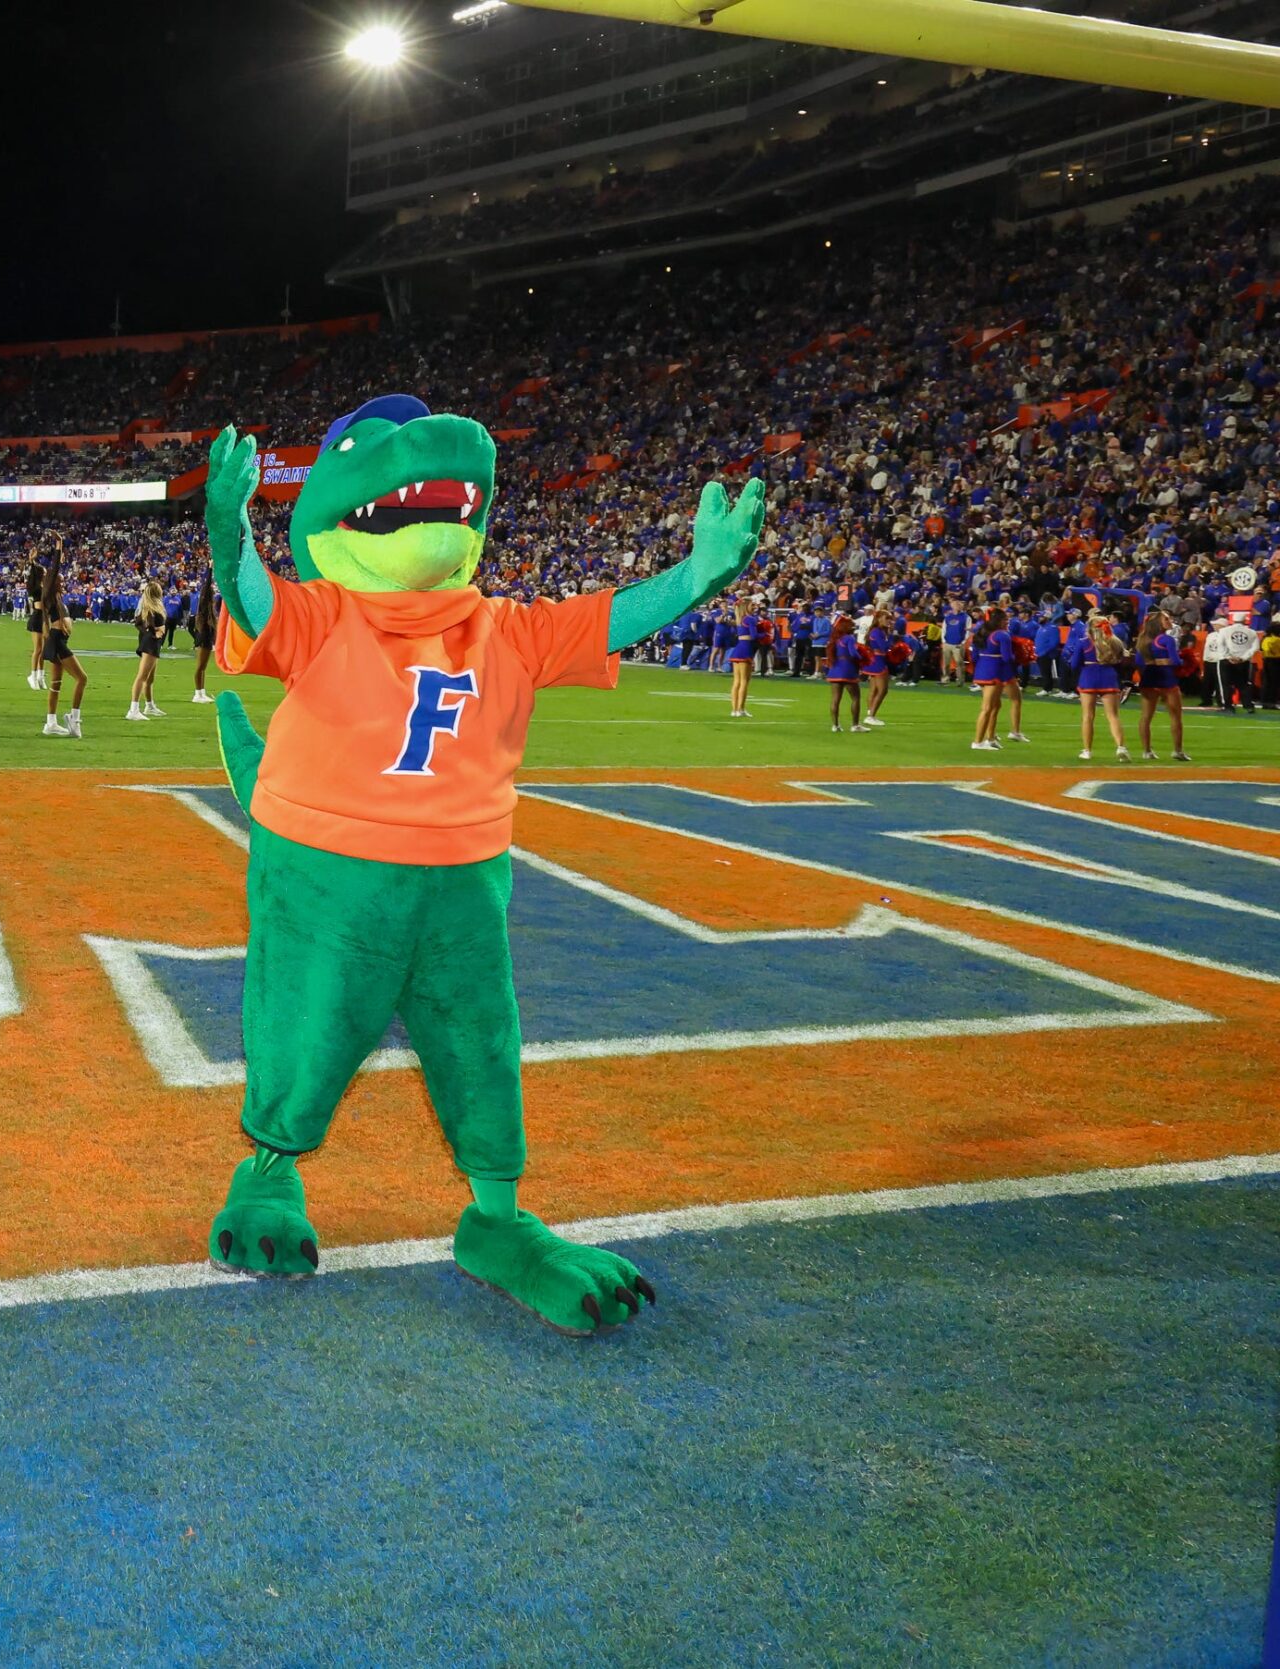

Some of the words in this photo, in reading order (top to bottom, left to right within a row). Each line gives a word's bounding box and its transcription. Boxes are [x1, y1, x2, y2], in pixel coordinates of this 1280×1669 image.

[68, 488, 83, 499] 2ND
[838, 585, 849, 601] 2
[381, 666, 480, 777] F
